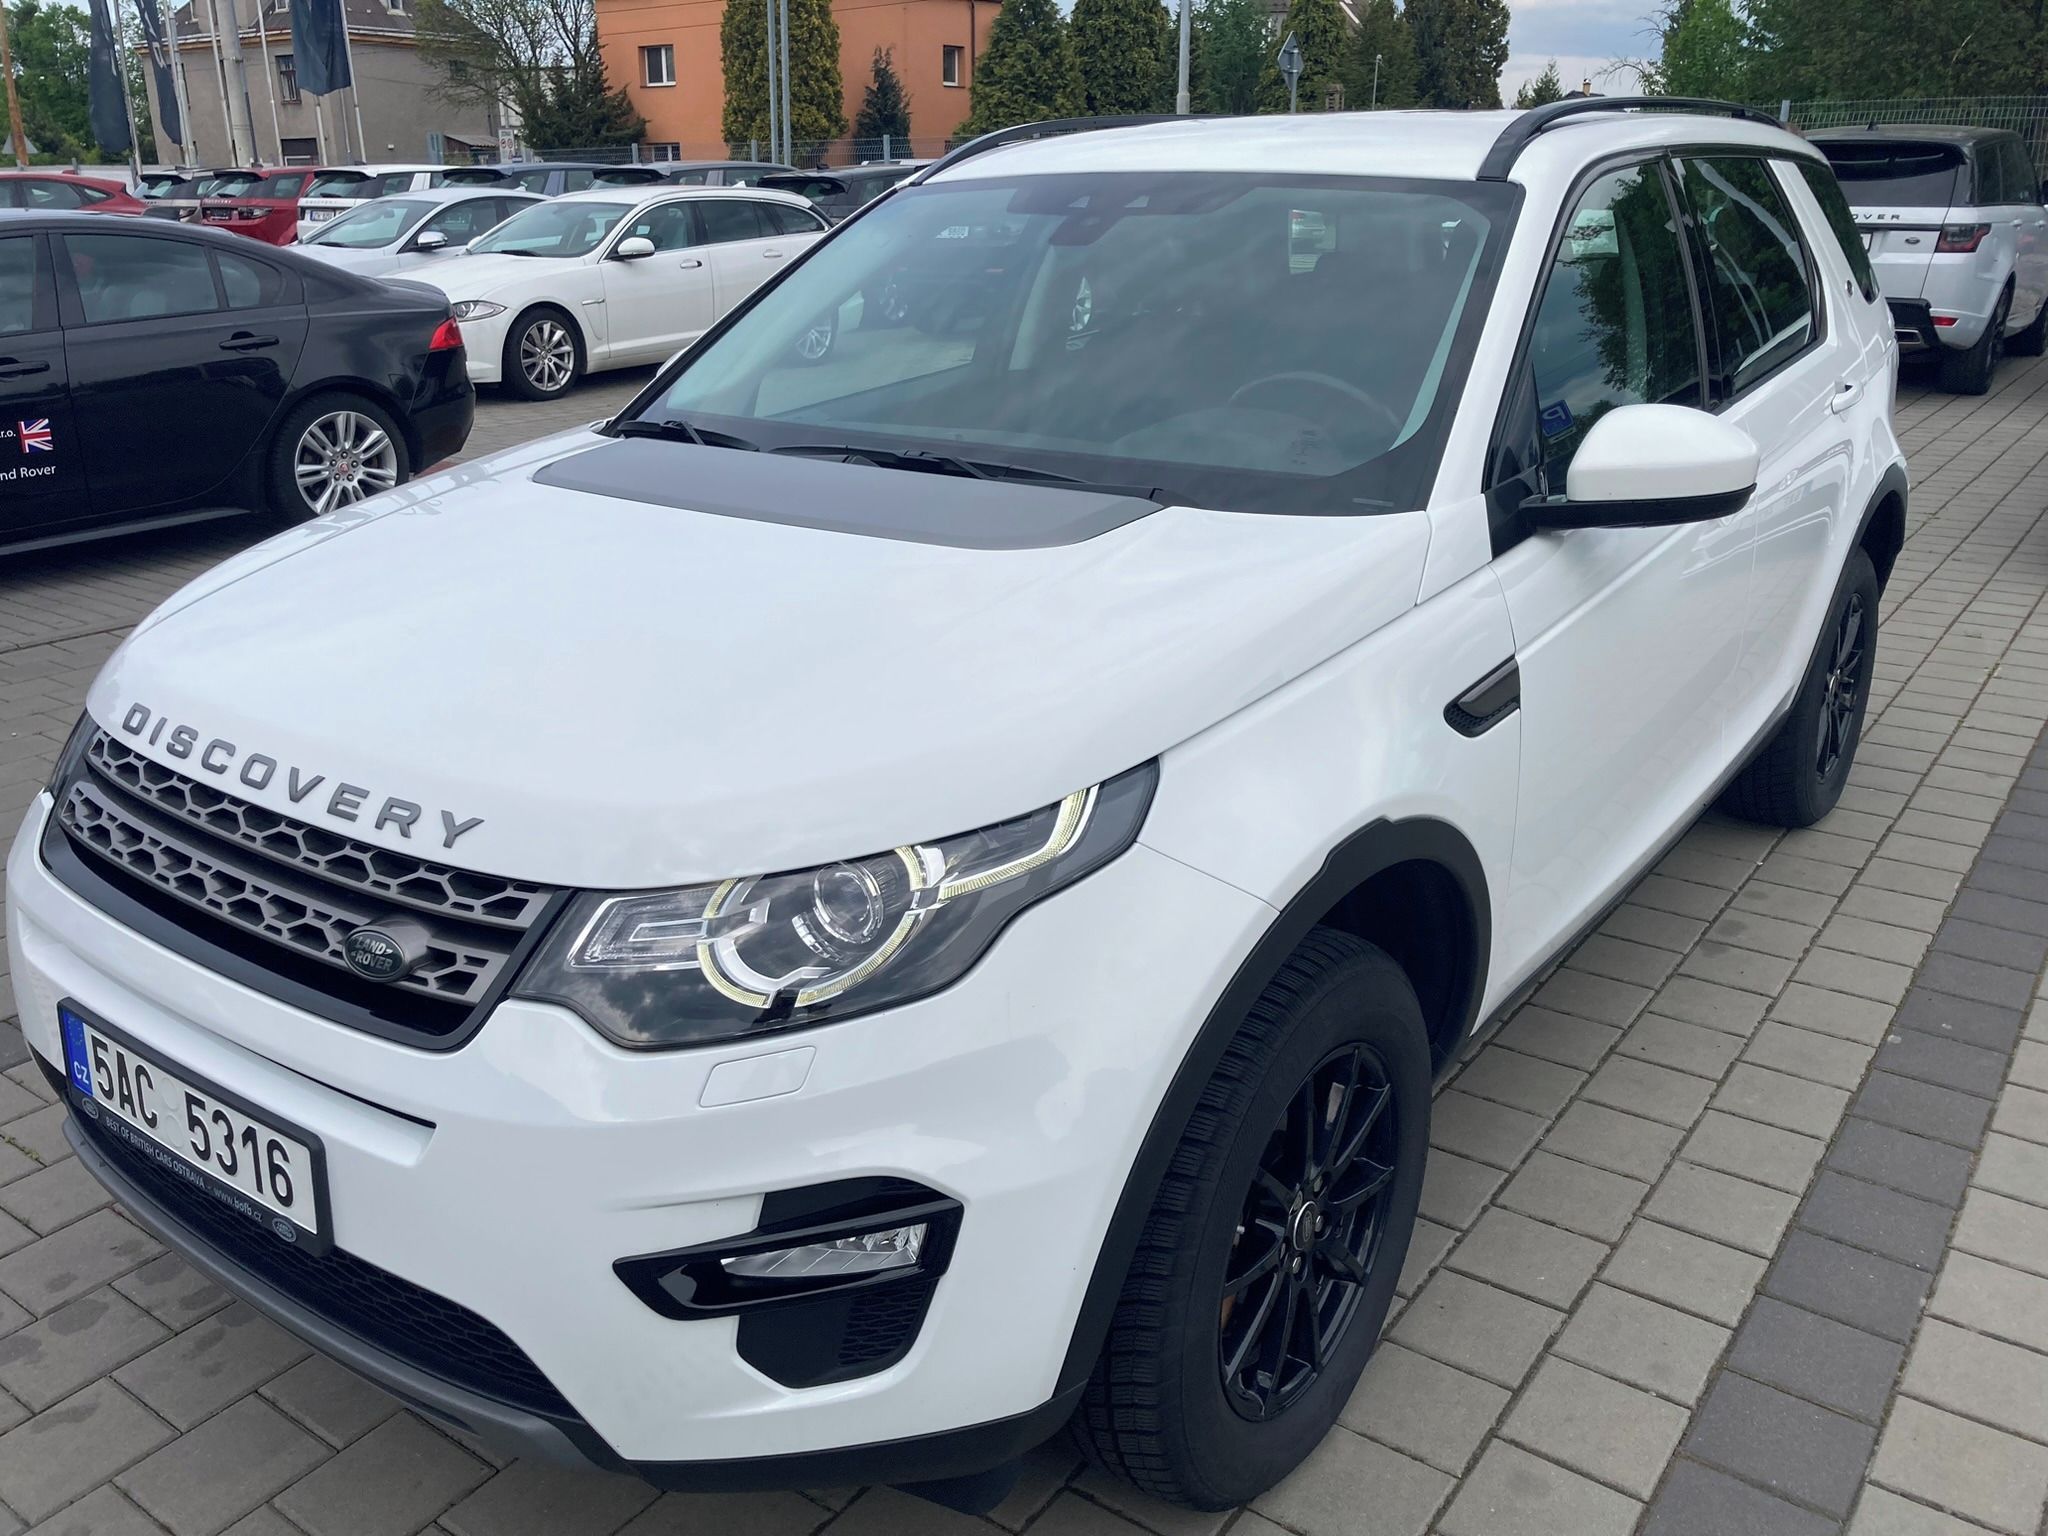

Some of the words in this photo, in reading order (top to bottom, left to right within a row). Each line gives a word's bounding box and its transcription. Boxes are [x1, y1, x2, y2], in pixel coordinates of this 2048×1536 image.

[20, 465, 56, 478] Rover
[122, 702, 485, 849] DISCOVERY
[355, 937, 387, 955] LAND
[354, 950, 393, 971] ROVER
[74, 1061, 90, 1084] CZ
[91, 1034, 158, 1129] 5AC
[184, 1090, 294, 1208] 5316
[105, 1116, 120, 1133] BEST
[121, 1126, 130, 1140] OF
[130, 1132, 155, 1157] BRITISH
[155, 1148, 172, 1169] CARS
[173, 1160, 206, 1190] OSTRAVA
